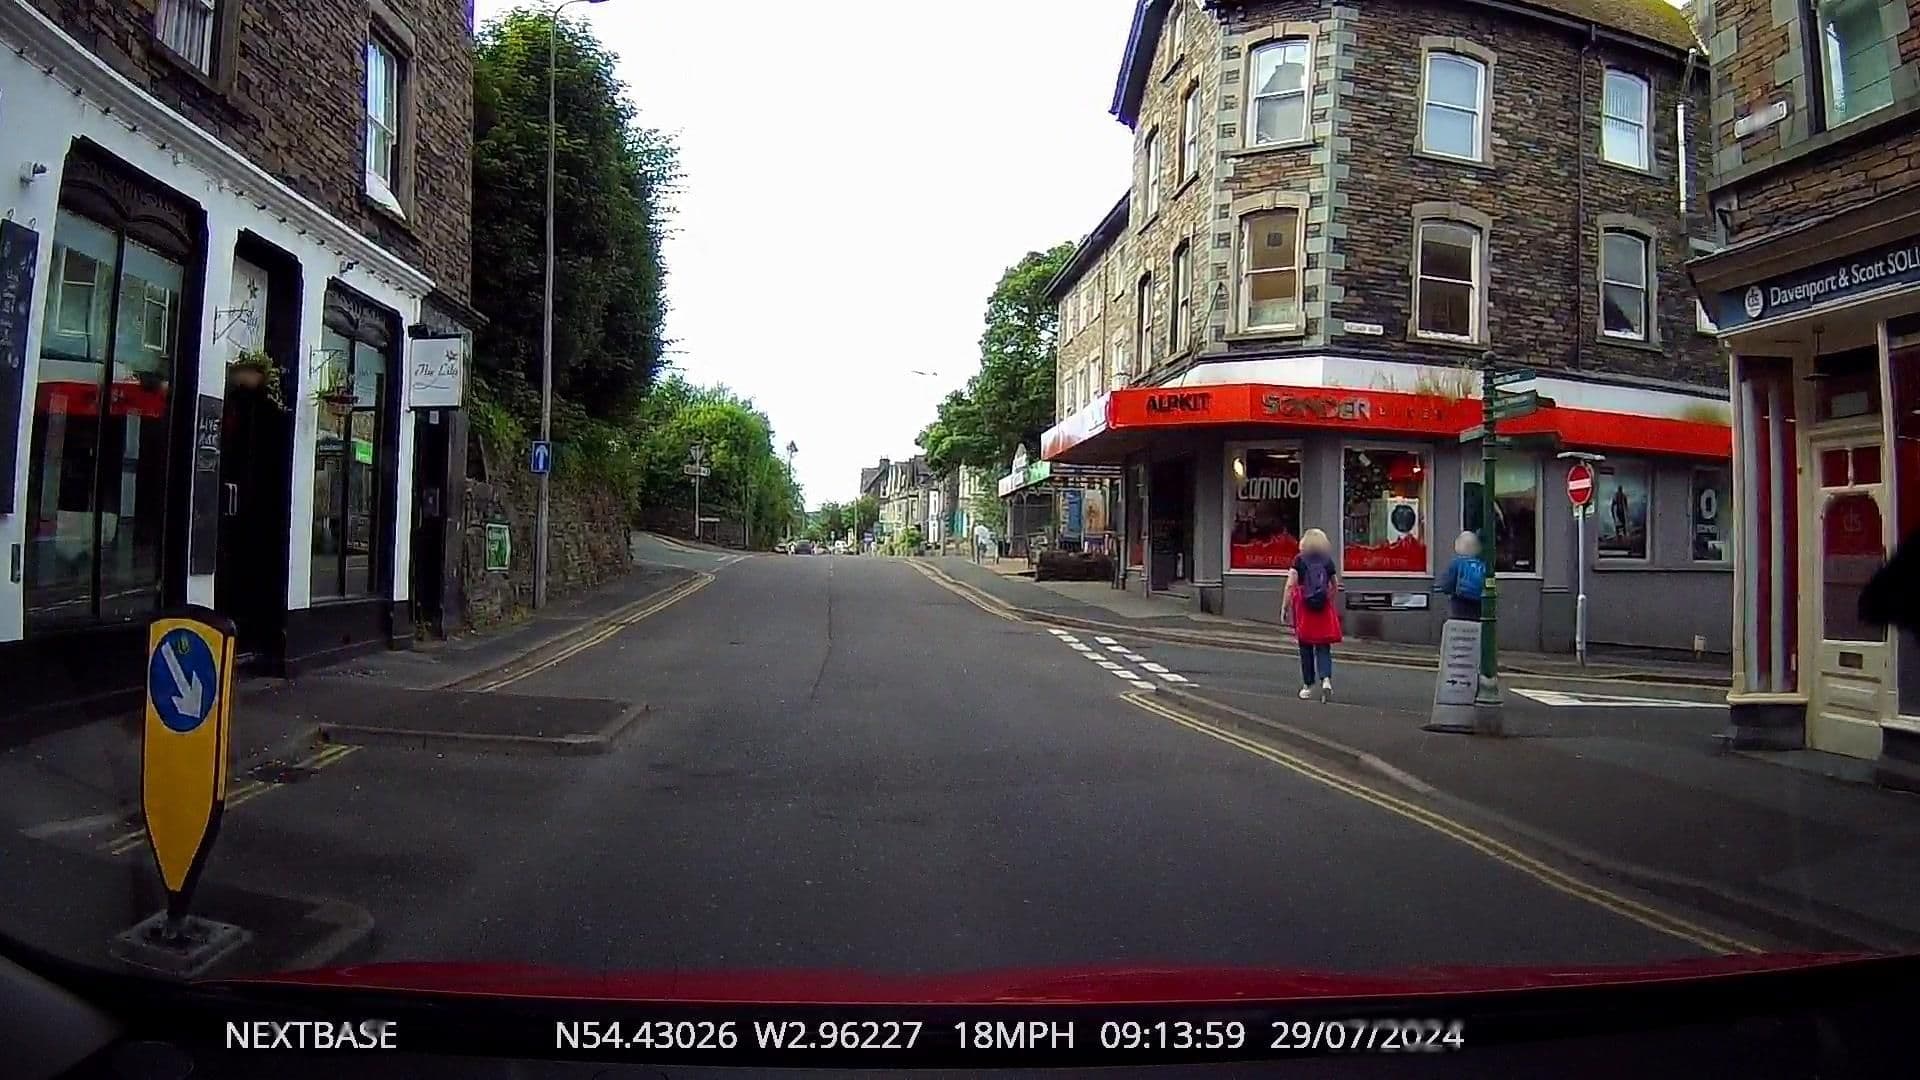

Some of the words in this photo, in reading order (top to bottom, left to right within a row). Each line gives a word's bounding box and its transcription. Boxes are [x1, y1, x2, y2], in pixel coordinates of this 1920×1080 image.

[1770, 275, 1838, 307] Davenport
[1838, 267, 1849, 288] &
[1851, 261, 1887, 284] Scott
